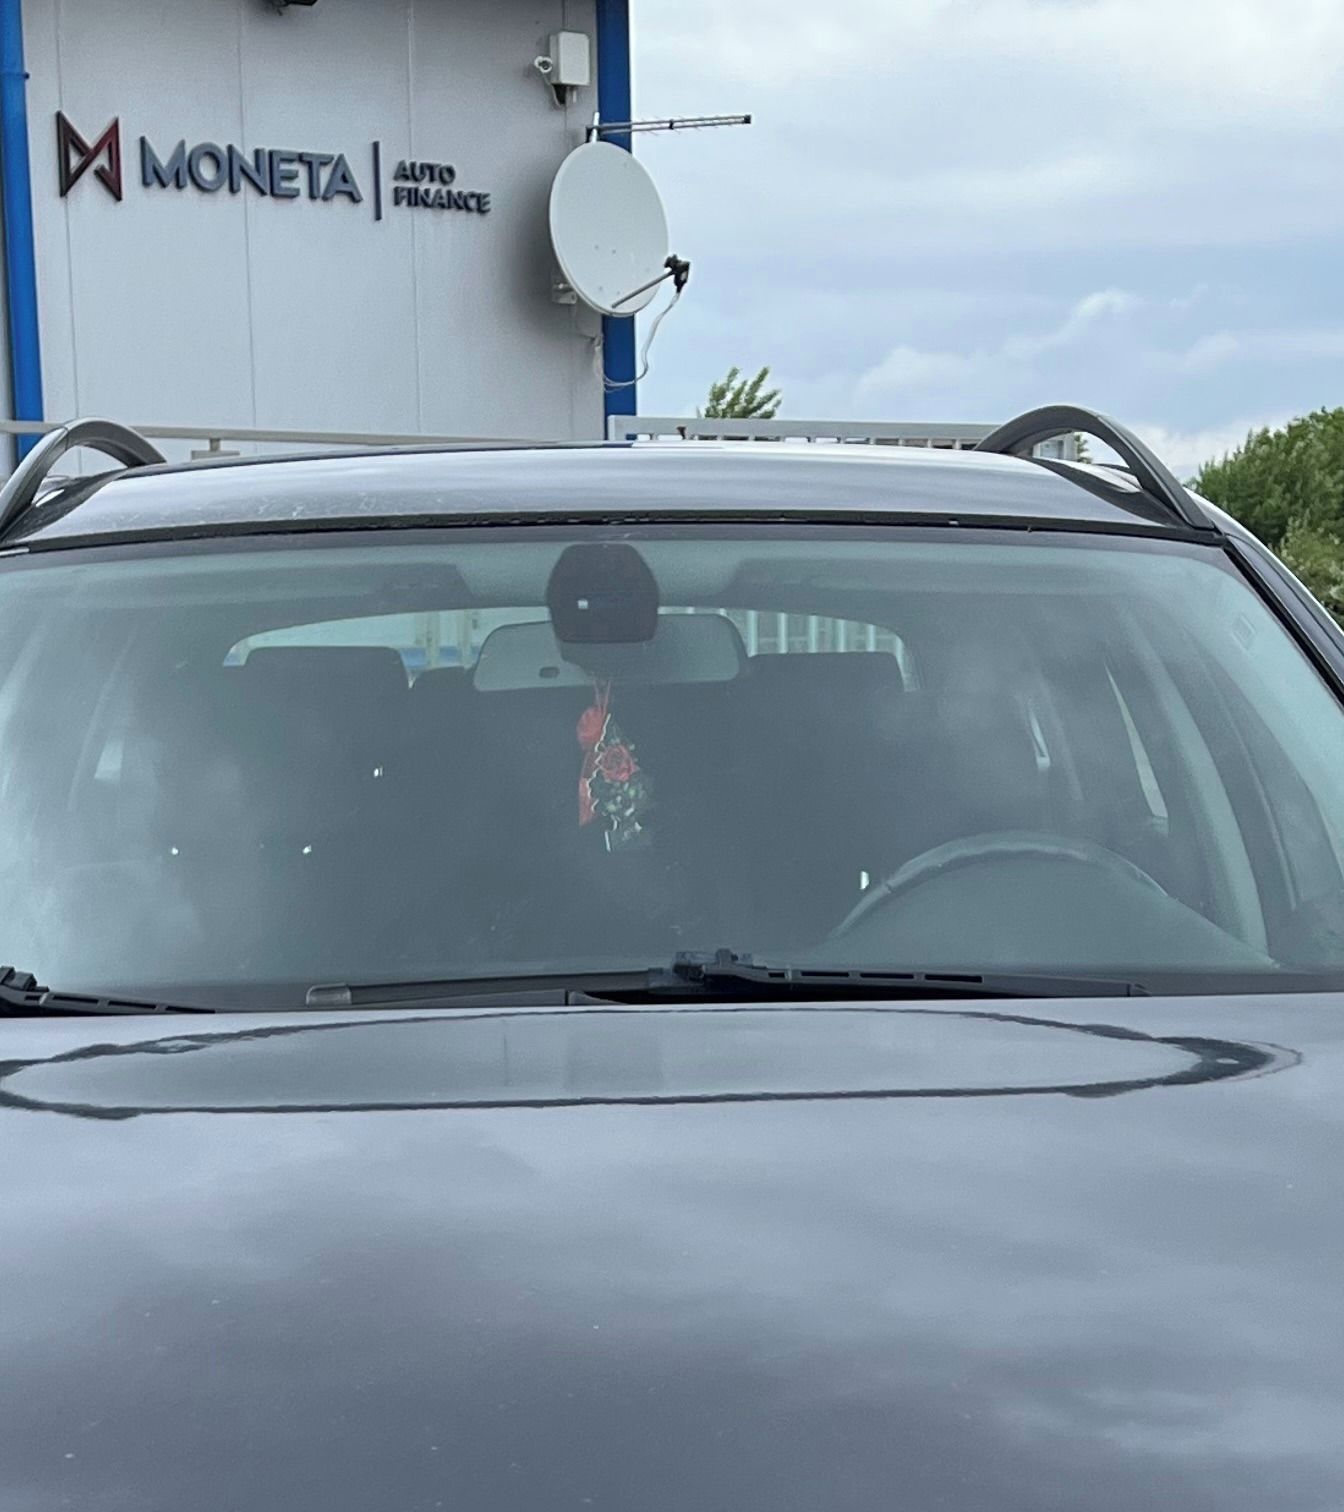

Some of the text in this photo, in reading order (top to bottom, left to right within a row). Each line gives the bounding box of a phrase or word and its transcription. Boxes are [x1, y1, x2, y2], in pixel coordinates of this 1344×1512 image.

[140, 135, 363, 204] MONETA
[393, 159, 456, 186] AUTO
[393, 186, 491, 215] FINANCE
